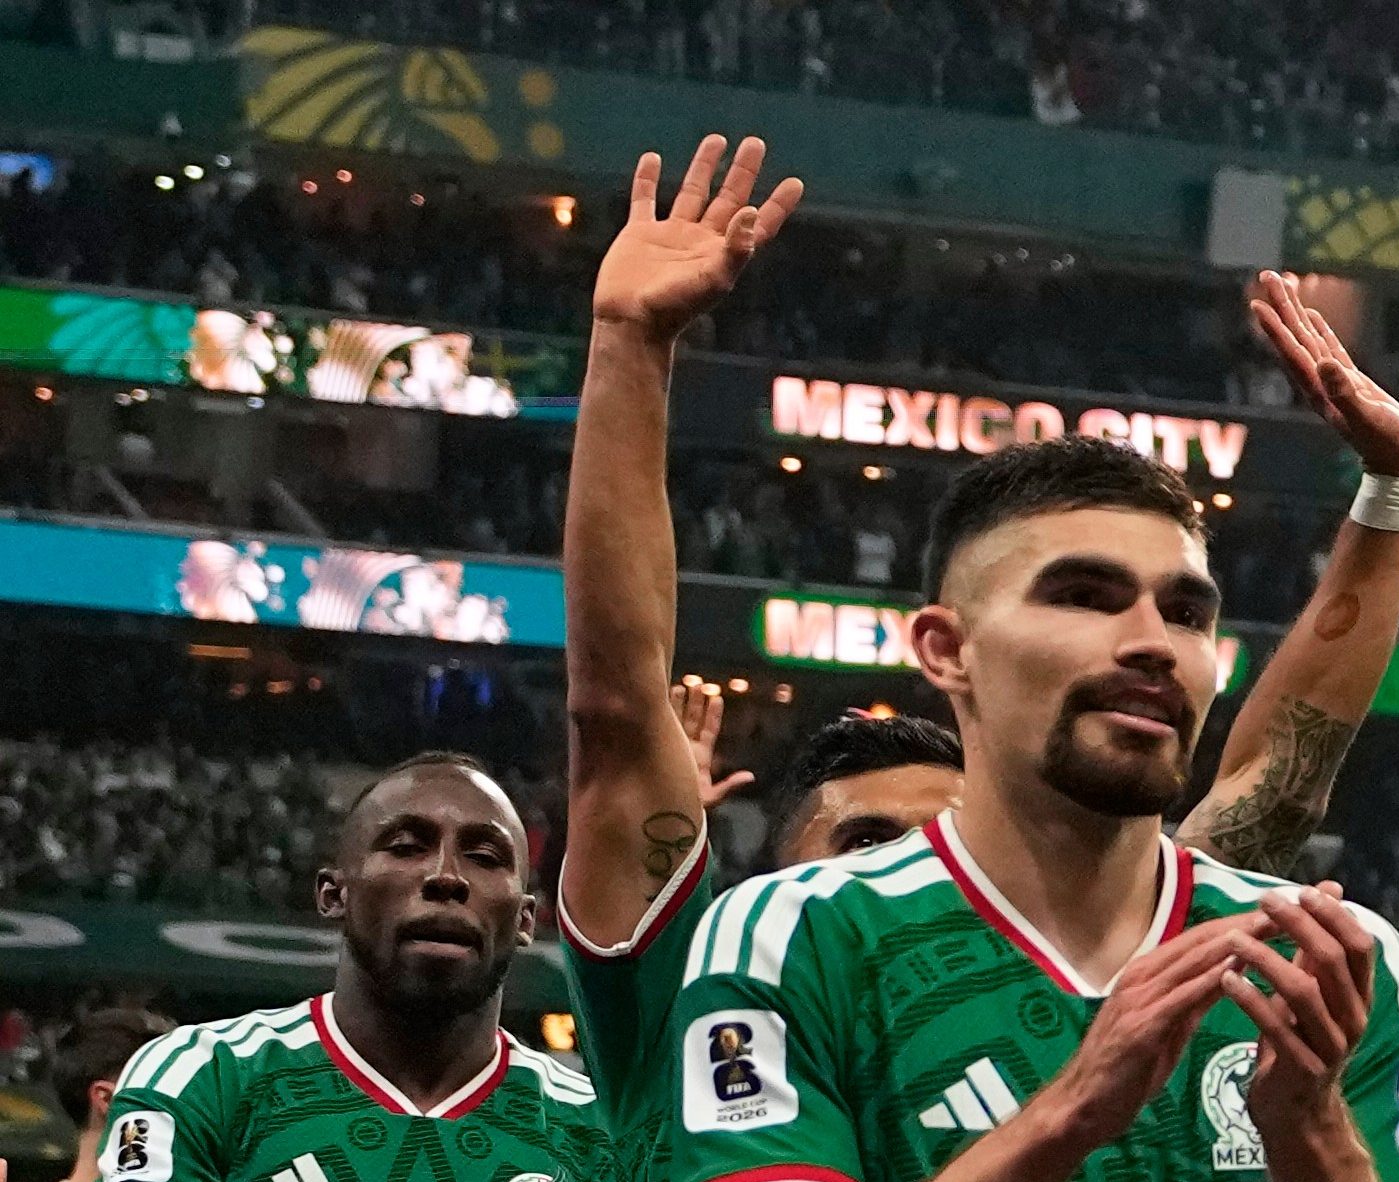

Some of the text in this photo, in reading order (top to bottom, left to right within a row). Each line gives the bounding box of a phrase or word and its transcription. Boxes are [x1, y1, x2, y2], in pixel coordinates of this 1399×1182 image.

[772, 375, 1248, 479] MEXICO CITY
[765, 599, 922, 668] MEX
[716, 1107, 767, 1122] 2026
